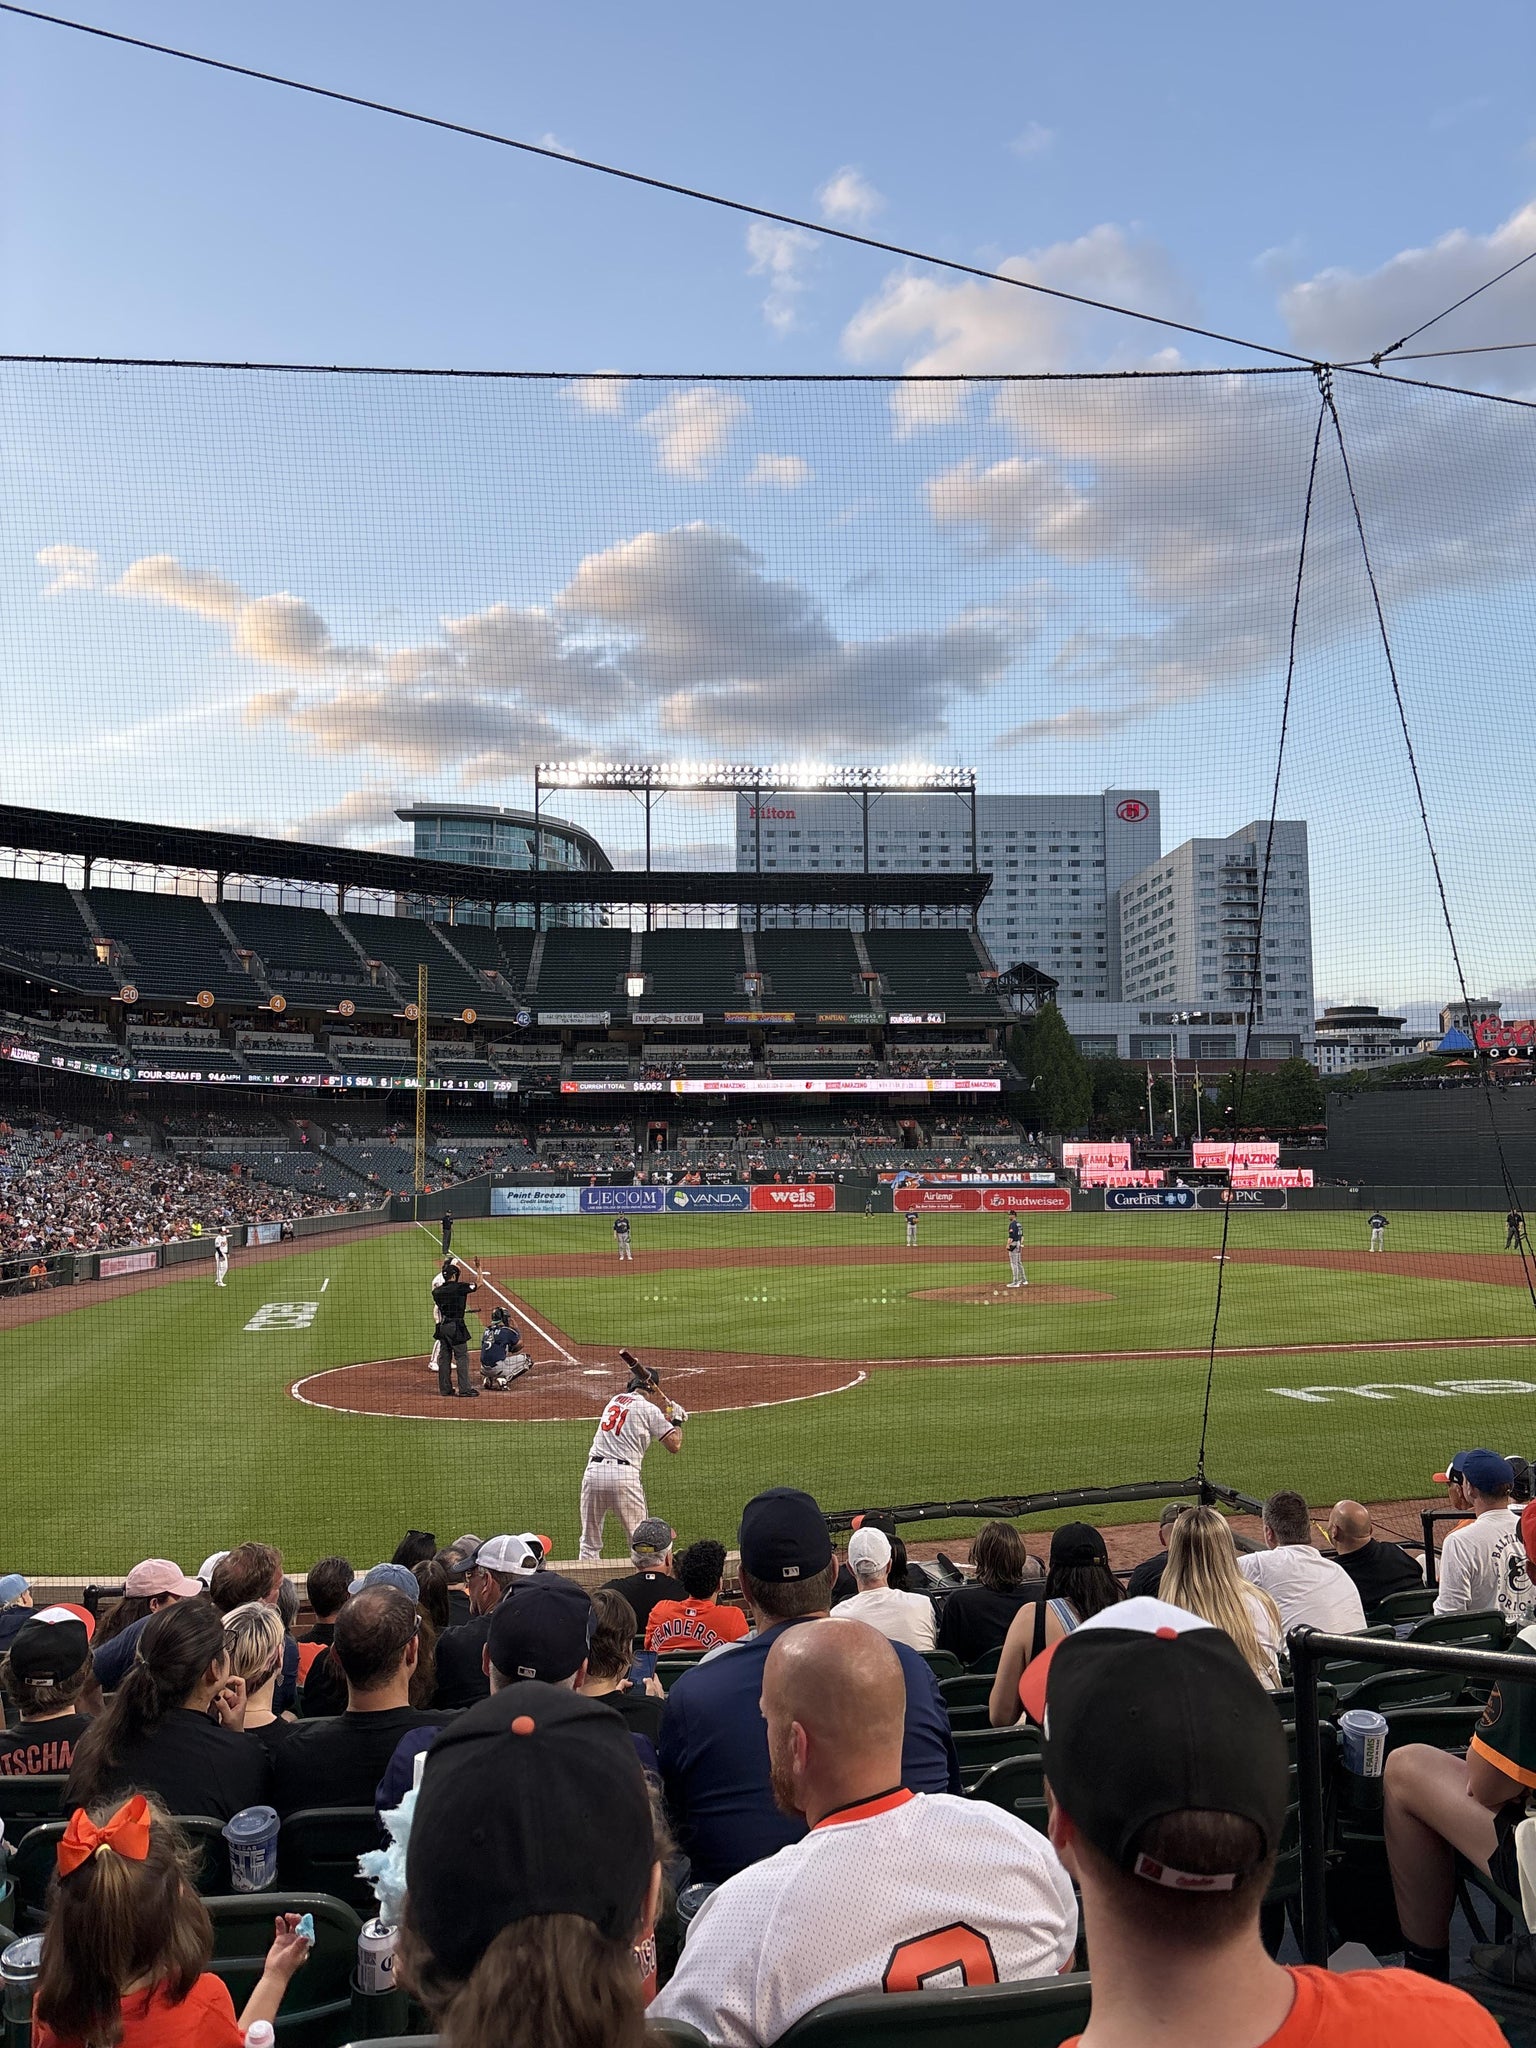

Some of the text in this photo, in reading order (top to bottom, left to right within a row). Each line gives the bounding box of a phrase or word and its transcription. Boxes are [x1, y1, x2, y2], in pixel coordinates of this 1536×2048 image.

[123, 989, 136, 1000] 20
[202, 994, 209, 1004] 5
[274, 999, 281, 1009] 4
[341, 1003, 353, 1012] 22
[407, 1008, 418, 1017] 33
[518, 1014, 529, 1023] 42
[1473, 1015, 1536, 1048] Coo
[138, 1070, 189, 1080] FOUR-SEAM
[190, 1072, 202, 1081] FB
[355, 1077, 374, 1086] SEA
[493, 1081, 512, 1090] 7:59
[633, 1081, 663, 1092] $5,052
[961, 1173, 1021, 1182] BIRD BATH
[588, 1191, 657, 1205] LECOM
[689, 1193, 743, 1203] VANDA
[770, 1188, 816, 1204] weis
[923, 1191, 953, 1202] Airtemp
[1114, 1192, 1164, 1206] CareFirst
[1235, 1190, 1263, 1202] PNC
[601, 1404, 630, 1437] 31
